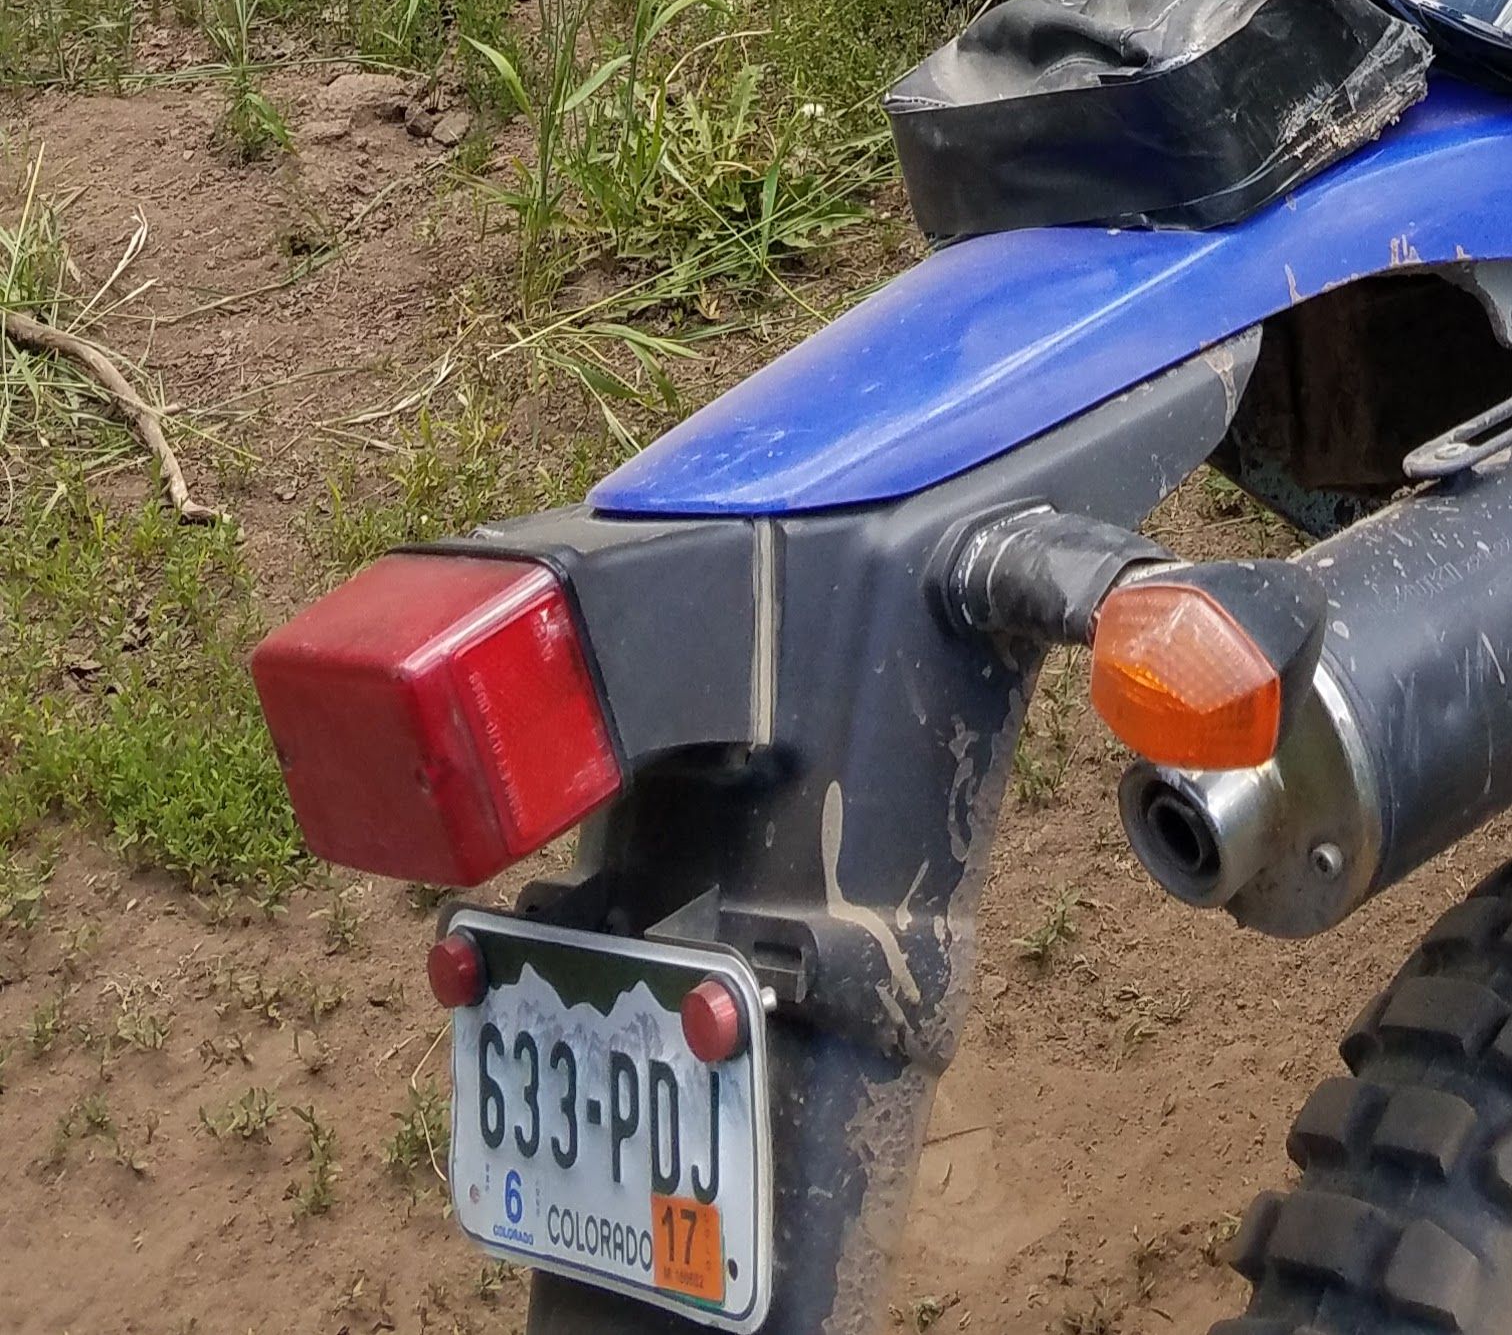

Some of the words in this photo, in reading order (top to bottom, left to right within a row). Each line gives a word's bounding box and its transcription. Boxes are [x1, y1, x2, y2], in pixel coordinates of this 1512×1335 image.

[478, 1022, 720, 1205] 633-PDJ
[504, 1169, 523, 1224] 6
[547, 1204, 653, 1272] COLORADO
[661, 1204, 697, 1265] 17
